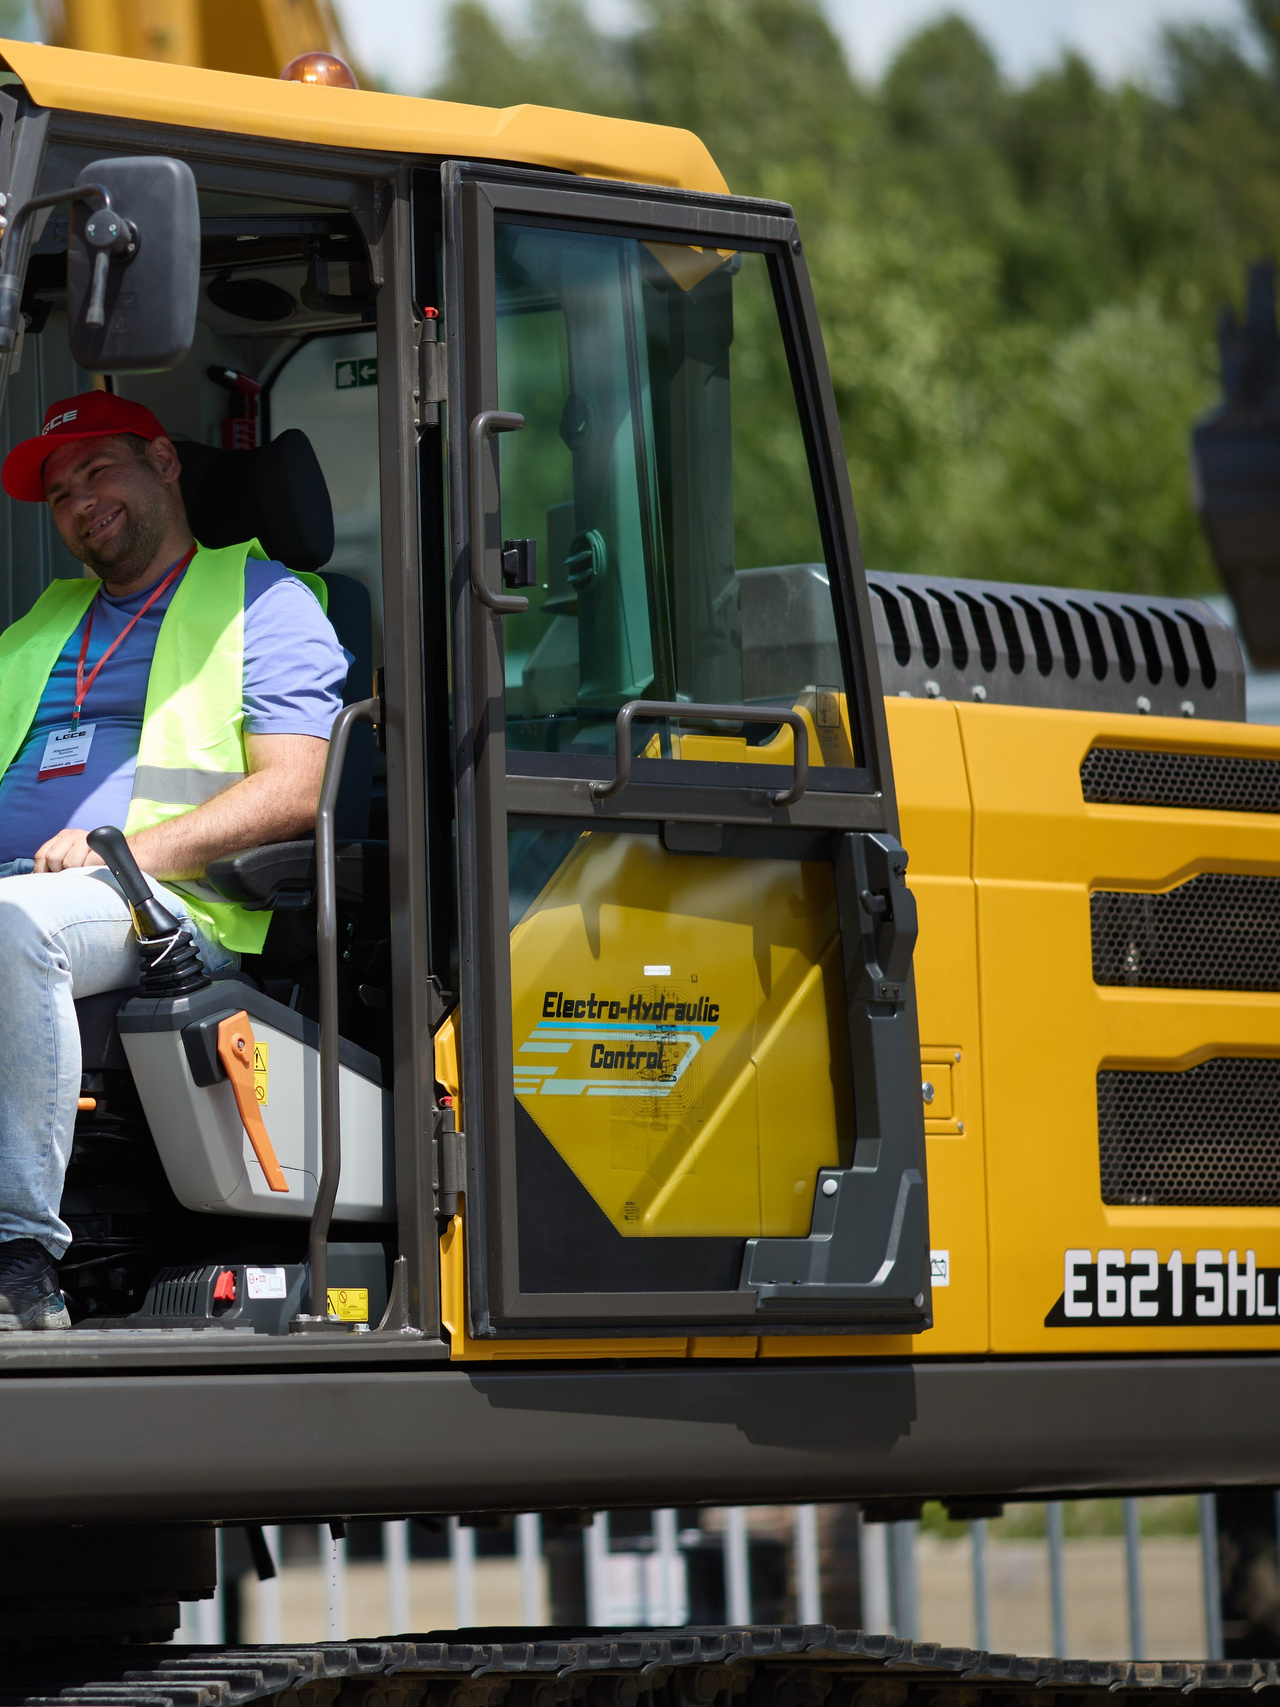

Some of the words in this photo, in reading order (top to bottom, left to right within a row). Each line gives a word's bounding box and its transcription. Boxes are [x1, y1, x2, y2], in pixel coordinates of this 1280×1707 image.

[55, 730, 87, 741] LGCE
[542, 991, 720, 1022] Electro-Hydraulic
[590, 1043, 664, 1070] Control
[1064, 1249, 1280, 1318] E6215HL
